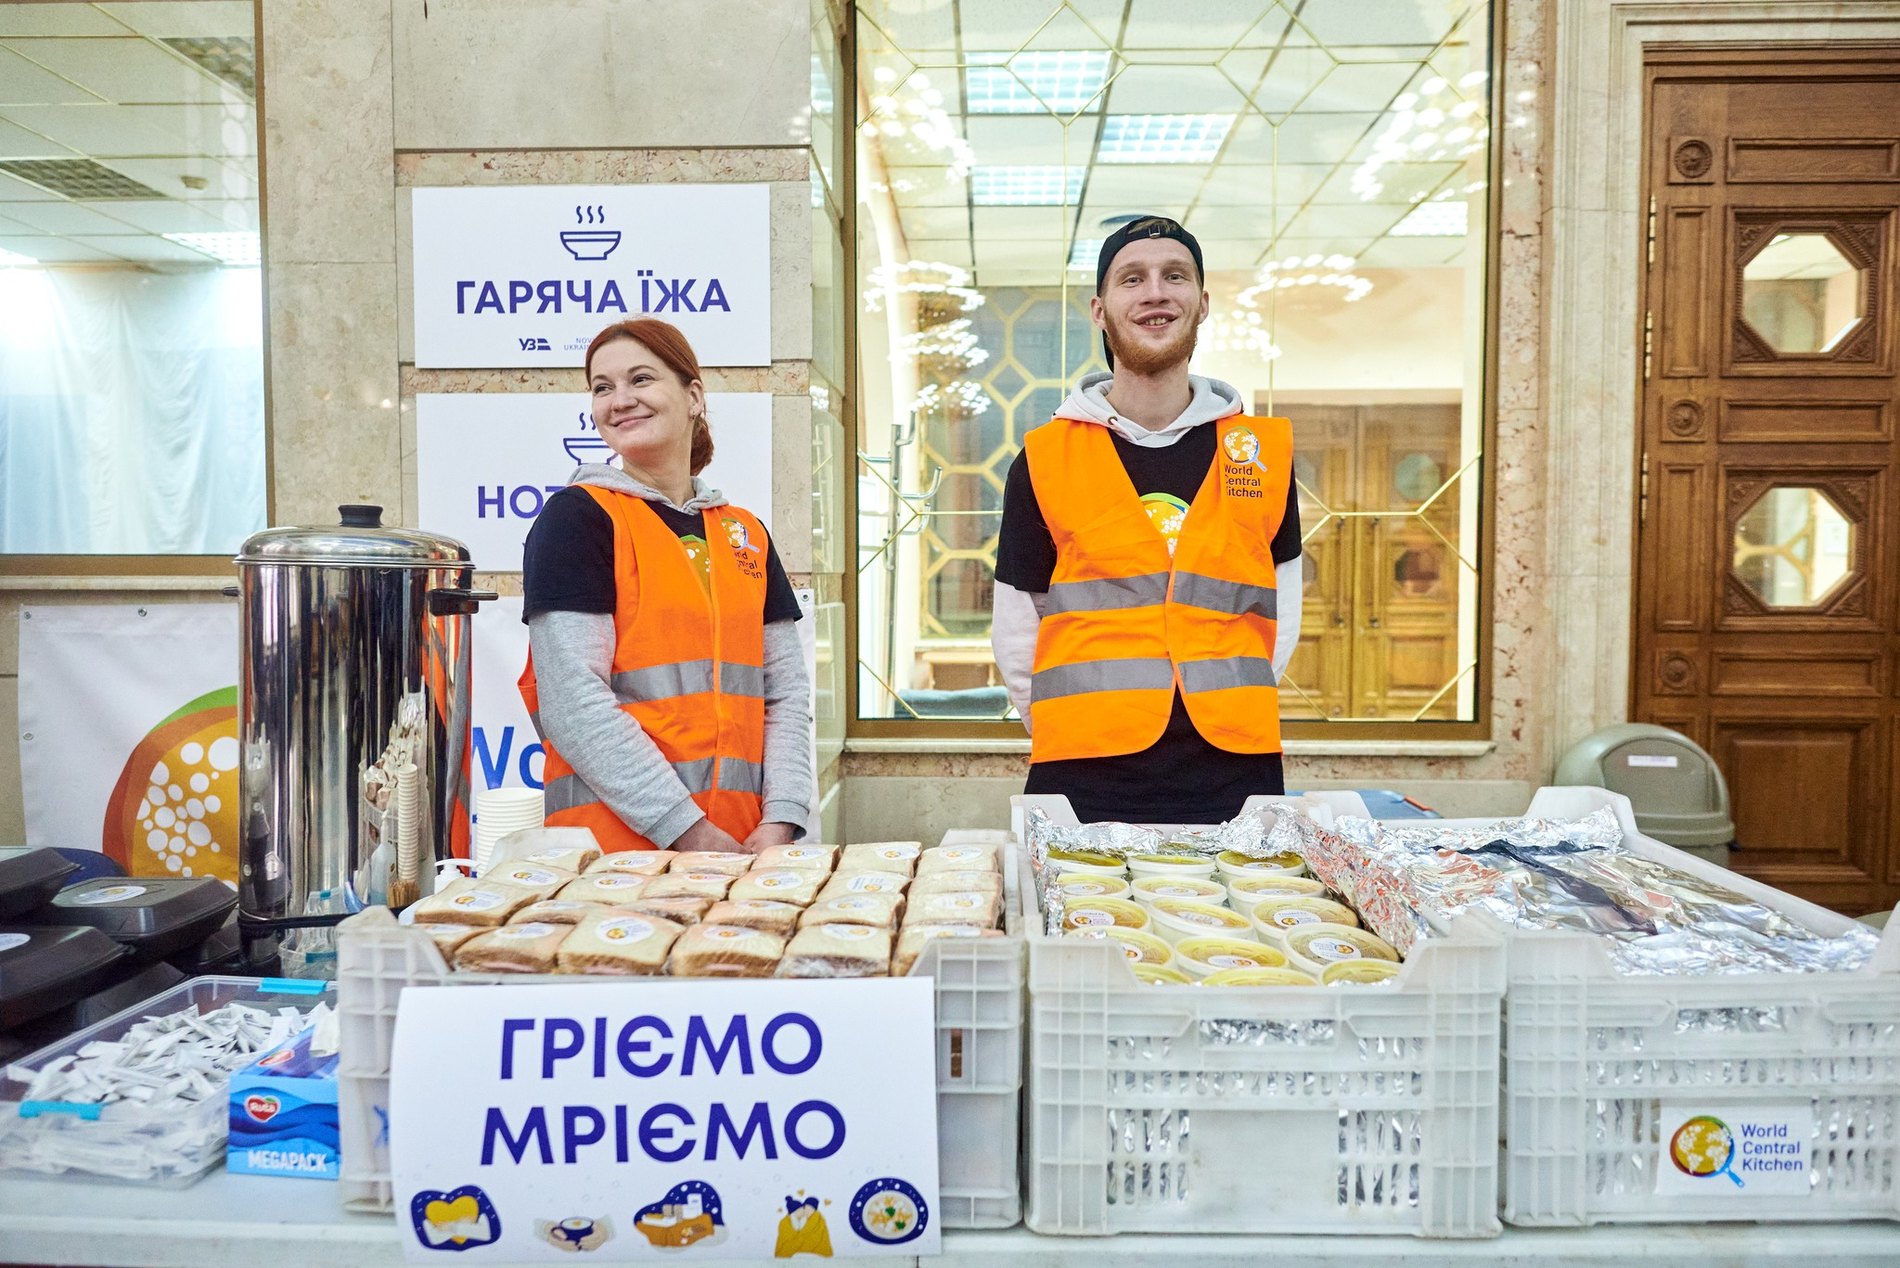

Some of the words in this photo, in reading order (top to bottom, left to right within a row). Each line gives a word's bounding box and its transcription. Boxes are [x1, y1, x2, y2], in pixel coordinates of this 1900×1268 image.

[456, 279, 628, 314] ГАРЯЧА
[637, 269, 731, 313] ЇЖА
[1226, 486, 1263, 498] itchen
[500, 1012, 823, 1080] ГРІЄМО
[480, 1100, 846, 1166] МРІЄМО
[1741, 1124, 1787, 1137] World
[1743, 1141, 1800, 1155] Central
[248, 1150, 327, 1172] MEGAPACK
[1742, 1158, 1803, 1171] Kitchen
